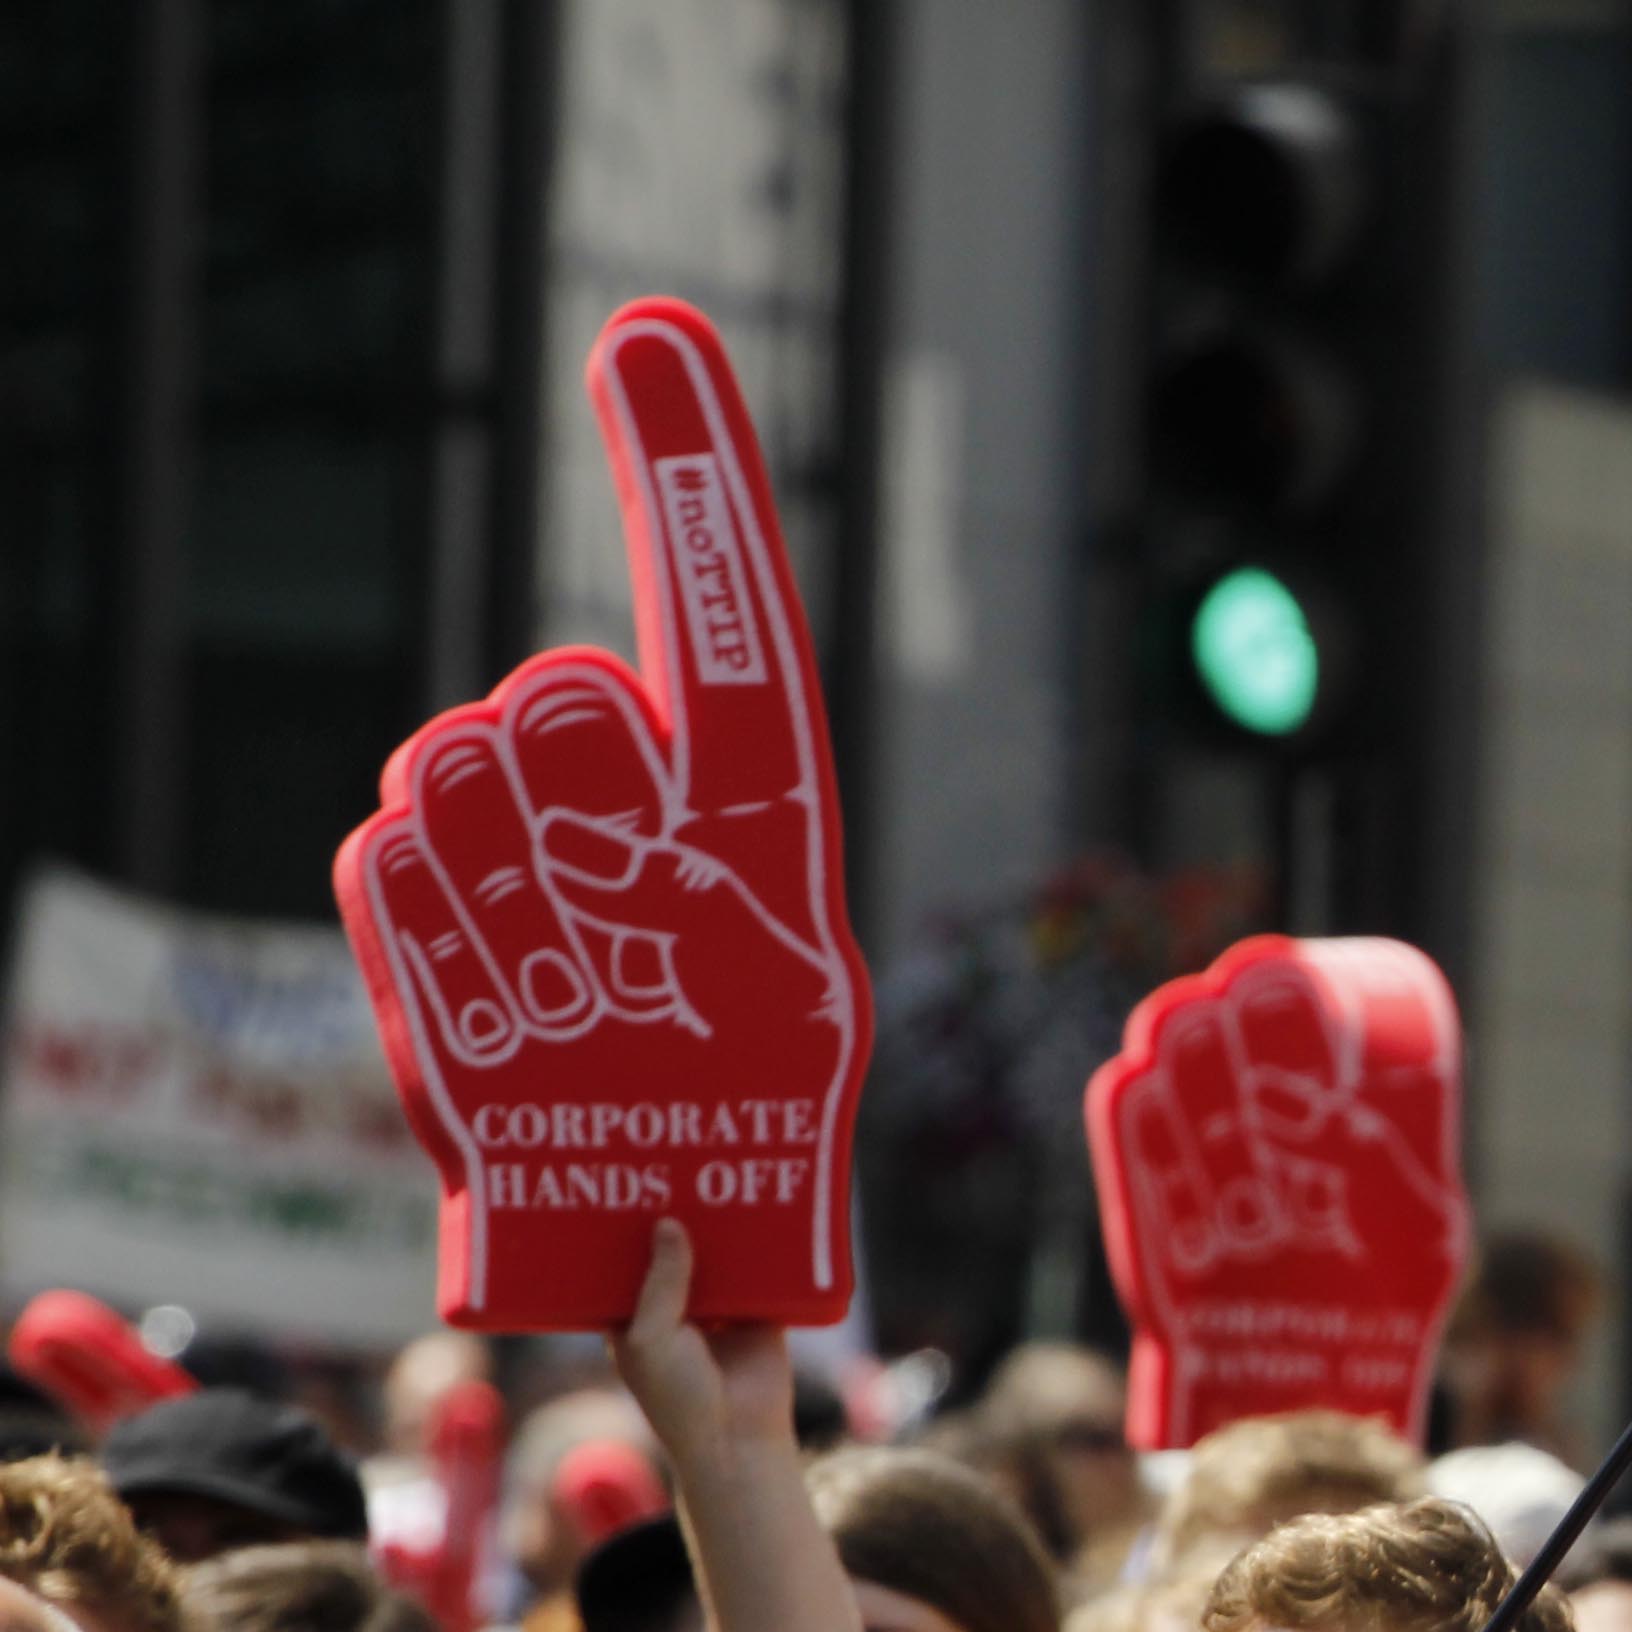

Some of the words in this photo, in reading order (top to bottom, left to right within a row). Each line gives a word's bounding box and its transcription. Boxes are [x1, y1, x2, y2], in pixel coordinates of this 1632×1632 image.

[671, 465, 751, 673] #noTTIP
[472, 1099, 820, 1148] CORPORATE
[488, 1160, 671, 1209] HANDS
[695, 1158, 809, 1206] OFF
